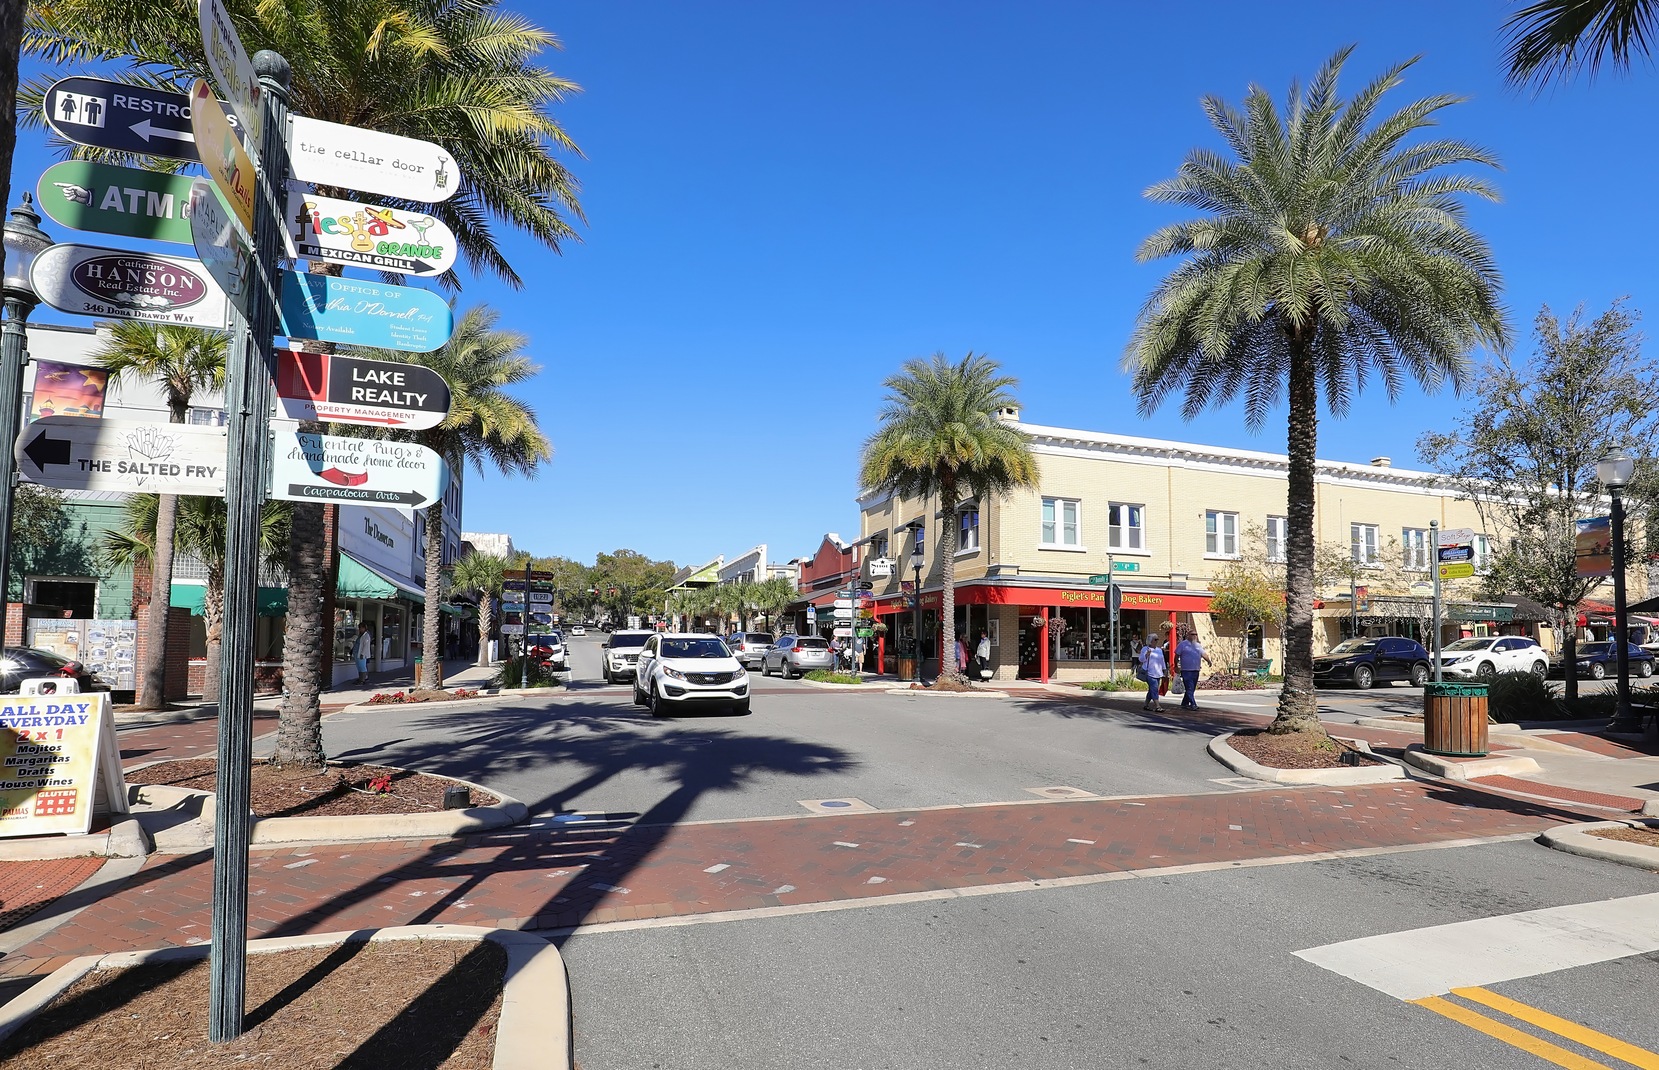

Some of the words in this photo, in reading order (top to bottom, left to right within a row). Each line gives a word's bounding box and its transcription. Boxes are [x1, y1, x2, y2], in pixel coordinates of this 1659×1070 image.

[211, 1, 237, 59] Hospice
[211, 20, 240, 102] Resale
[242, 81, 260, 139] Shop
[112, 93, 239, 128] RESTROS
[300, 142, 326, 155] the
[335, 149, 384, 166] cellar
[392, 158, 425, 174] door
[100, 184, 174, 220] ATM
[295, 201, 389, 252] fiesta
[307, 246, 373, 263] MEXICAN
[374, 257, 415, 270] GRILL
[376, 241, 444, 260] GRANDE
[117, 258, 166, 272] Catherine
[86, 263, 195, 290] HANSON
[98, 280, 122, 291] Real
[126, 283, 160, 295] Estate
[163, 287, 183, 298] Inc.
[296, 277, 325, 288] LAW
[330, 281, 380, 296] OFFICE
[384, 290, 402, 299] OF
[83, 302, 105, 313] 346
[134, 310, 171, 321] DRAWDY
[173, 313, 195, 323] WAY
[325, 325, 355, 335] Available
[389, 323, 411, 332] Student
[390, 332, 412, 341] Identity
[353, 367, 405, 387] LAKE
[351, 387, 428, 407] REALTY
[304, 403, 352, 414] PROPERTY
[354, 408, 416, 420] MANAGEMENT
[299, 435, 365, 452] Oriental
[373, 441, 412, 459] Rugs
[287, 447, 360, 465] handmade
[363, 454, 393, 468] home
[397, 456, 426, 470] decor
[77, 458, 112, 473] THE
[117, 460, 181, 477] SALTED
[185, 465, 218, 479] FRY
[303, 485, 369, 499] Cappadocia
[1061, 591, 1089, 602] Piglet's
[1121, 594, 1137, 605] Dog
[1138, 594, 1163, 606] Bakery
[1, 704, 41, 717] ALL
[46, 703, 90, 715] DAY
[0, 714, 89, 728] EVERYDAY
[17, 729, 31, 742] 2
[35, 731, 48, 741] x
[55, 728, 64, 740] 1
[17, 744, 62, 755] Mojitos
[5, 755, 71, 767] Margaritas
[17, 767, 55, 777] Drafts
[37, 777, 73, 787] Wines
[36, 798, 76, 806] FREE
[38, 790, 77, 798] GLUTEN
[2, 807, 29, 816] PALMAS
[35, 806, 75, 815] MENU
